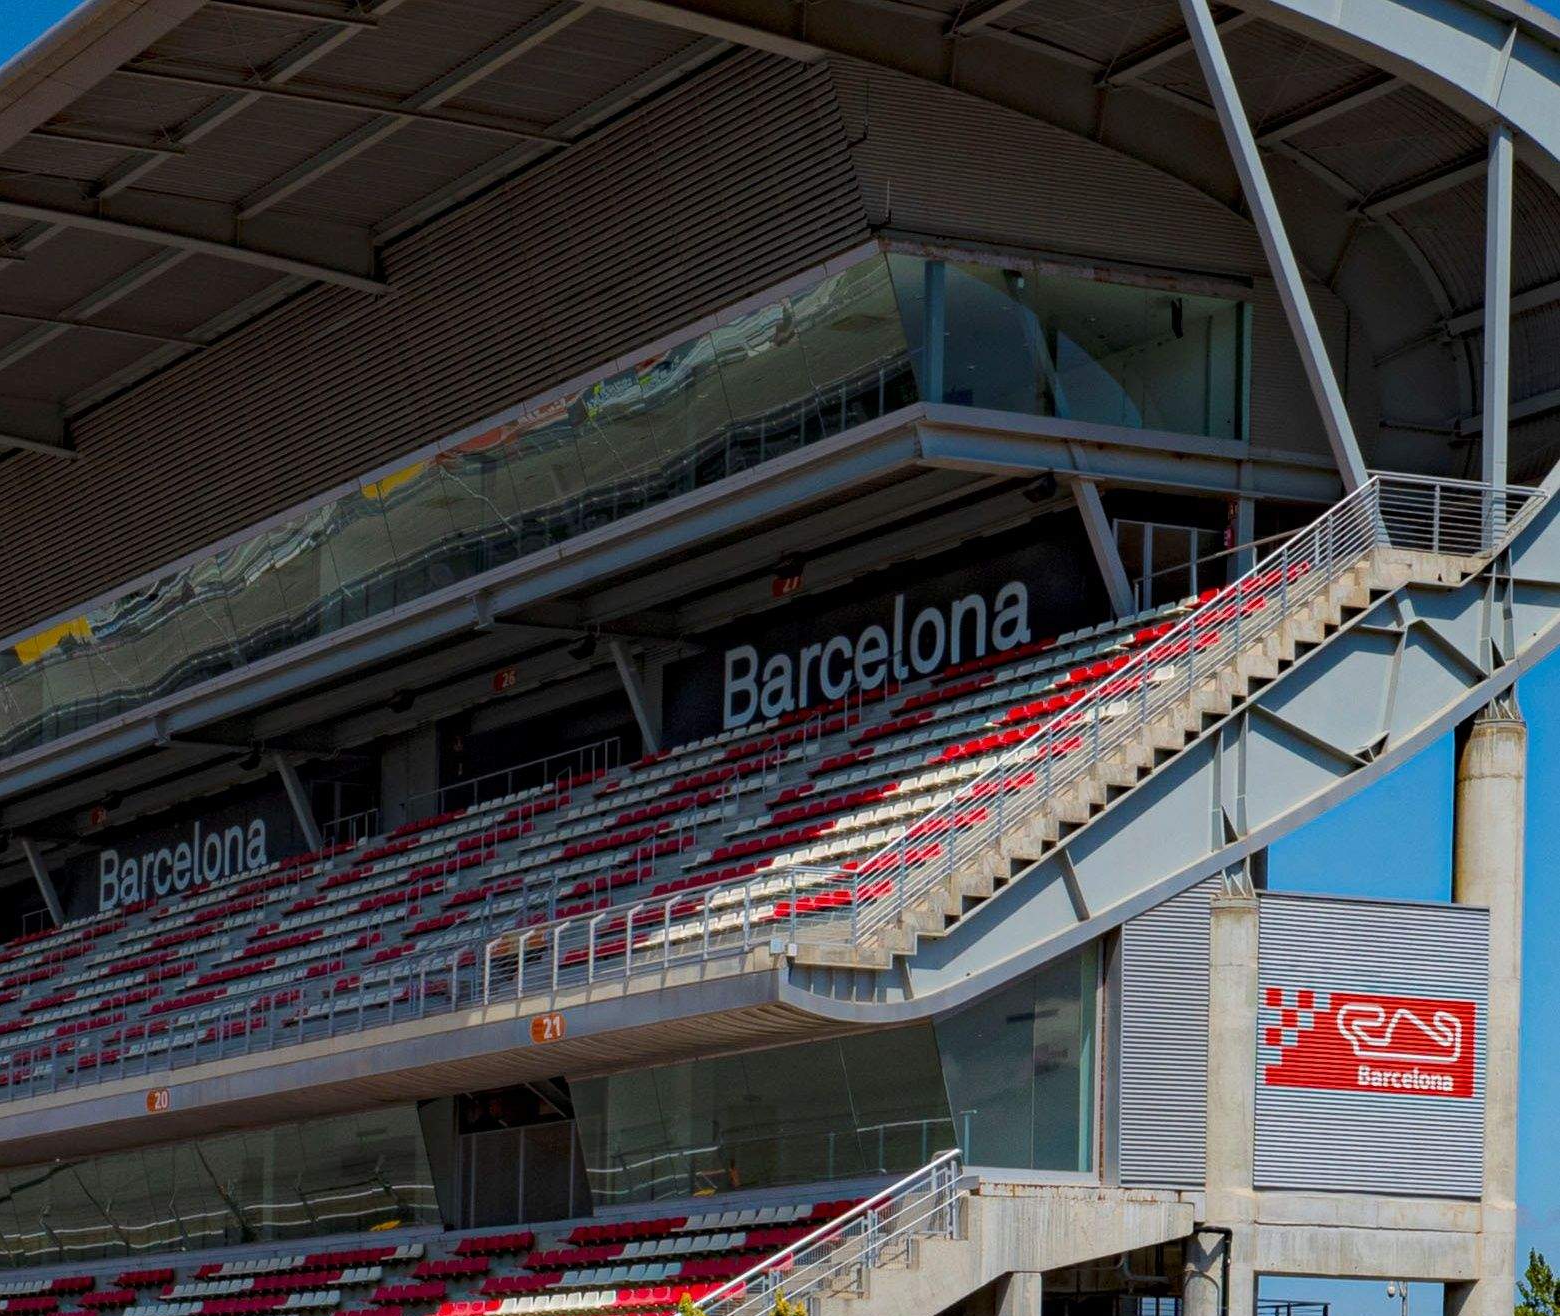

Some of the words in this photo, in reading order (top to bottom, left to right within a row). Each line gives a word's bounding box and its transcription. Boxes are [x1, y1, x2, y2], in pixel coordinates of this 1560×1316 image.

[723, 581, 1031, 730] Barcelona
[99, 818, 267, 912] Barcelona
[543, 1016, 561, 1039] 21
[1358, 1065, 1453, 1091] Barcelona
[154, 1091, 168, 1109] 20
